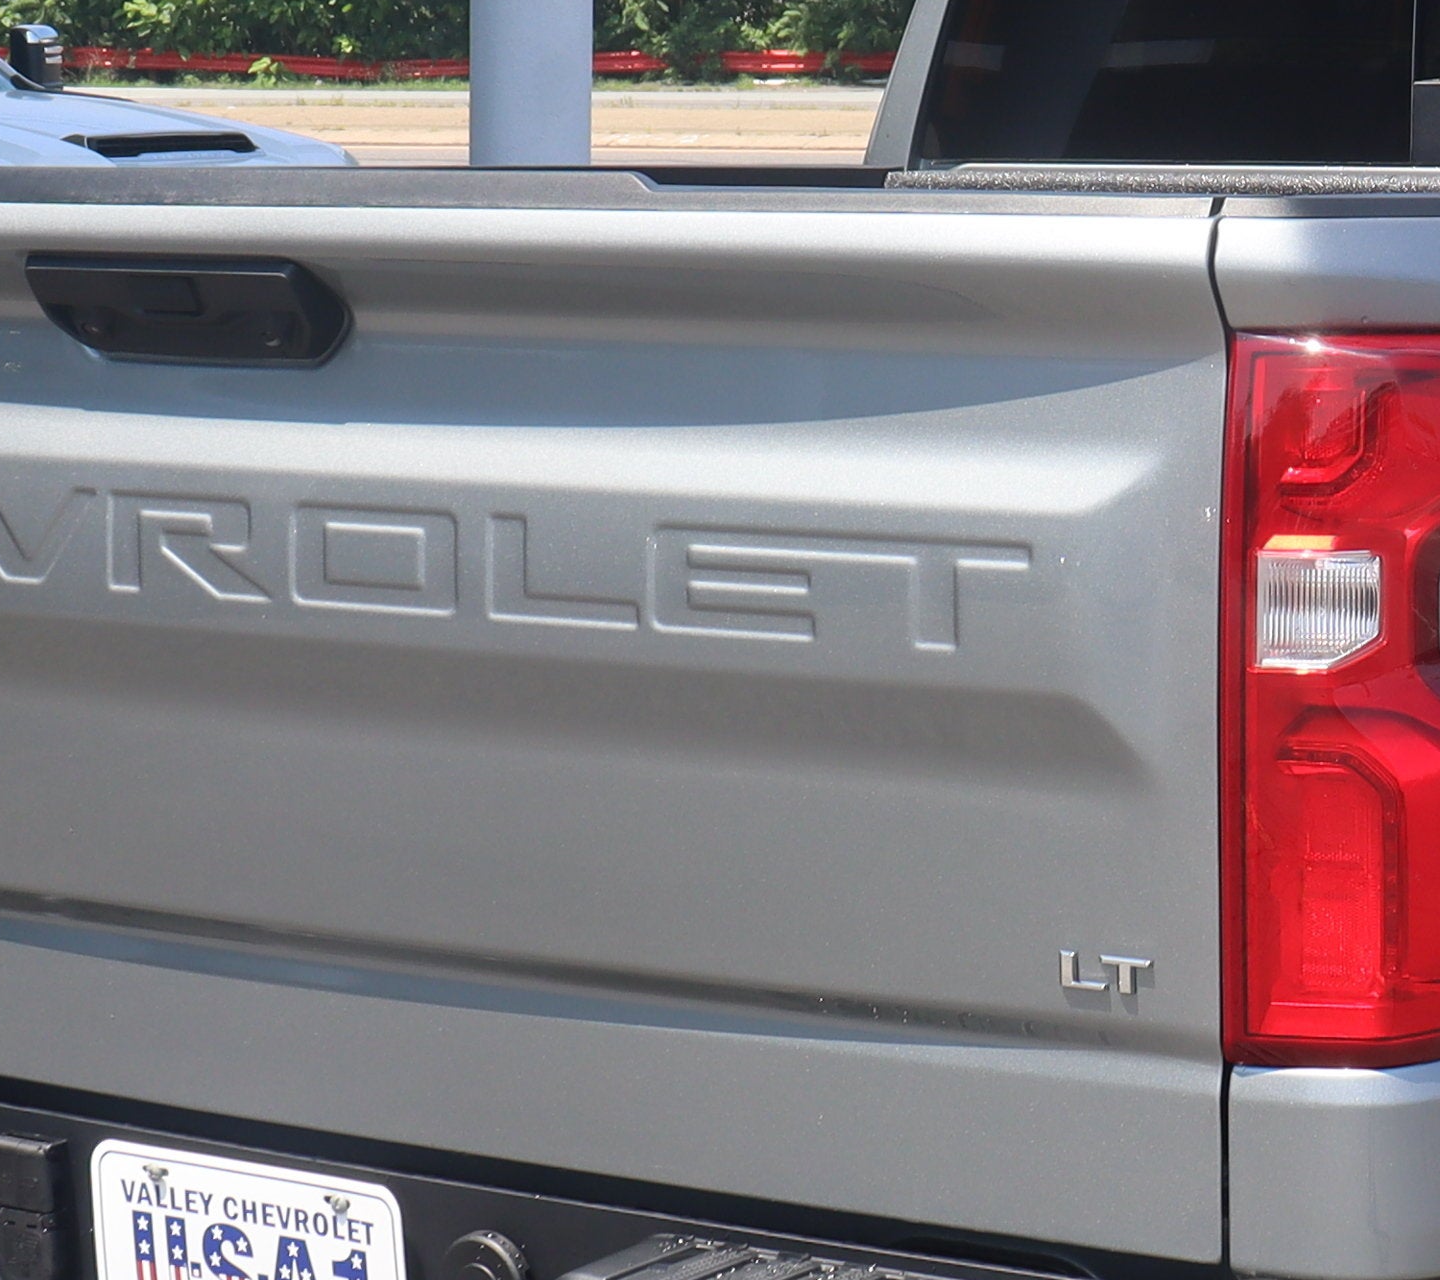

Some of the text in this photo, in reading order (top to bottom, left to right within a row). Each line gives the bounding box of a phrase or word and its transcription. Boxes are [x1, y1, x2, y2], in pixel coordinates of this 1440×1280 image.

[1060, 949, 1153, 995] LT
[121, 1179, 374, 1246] VALLEY CHEVROLET
